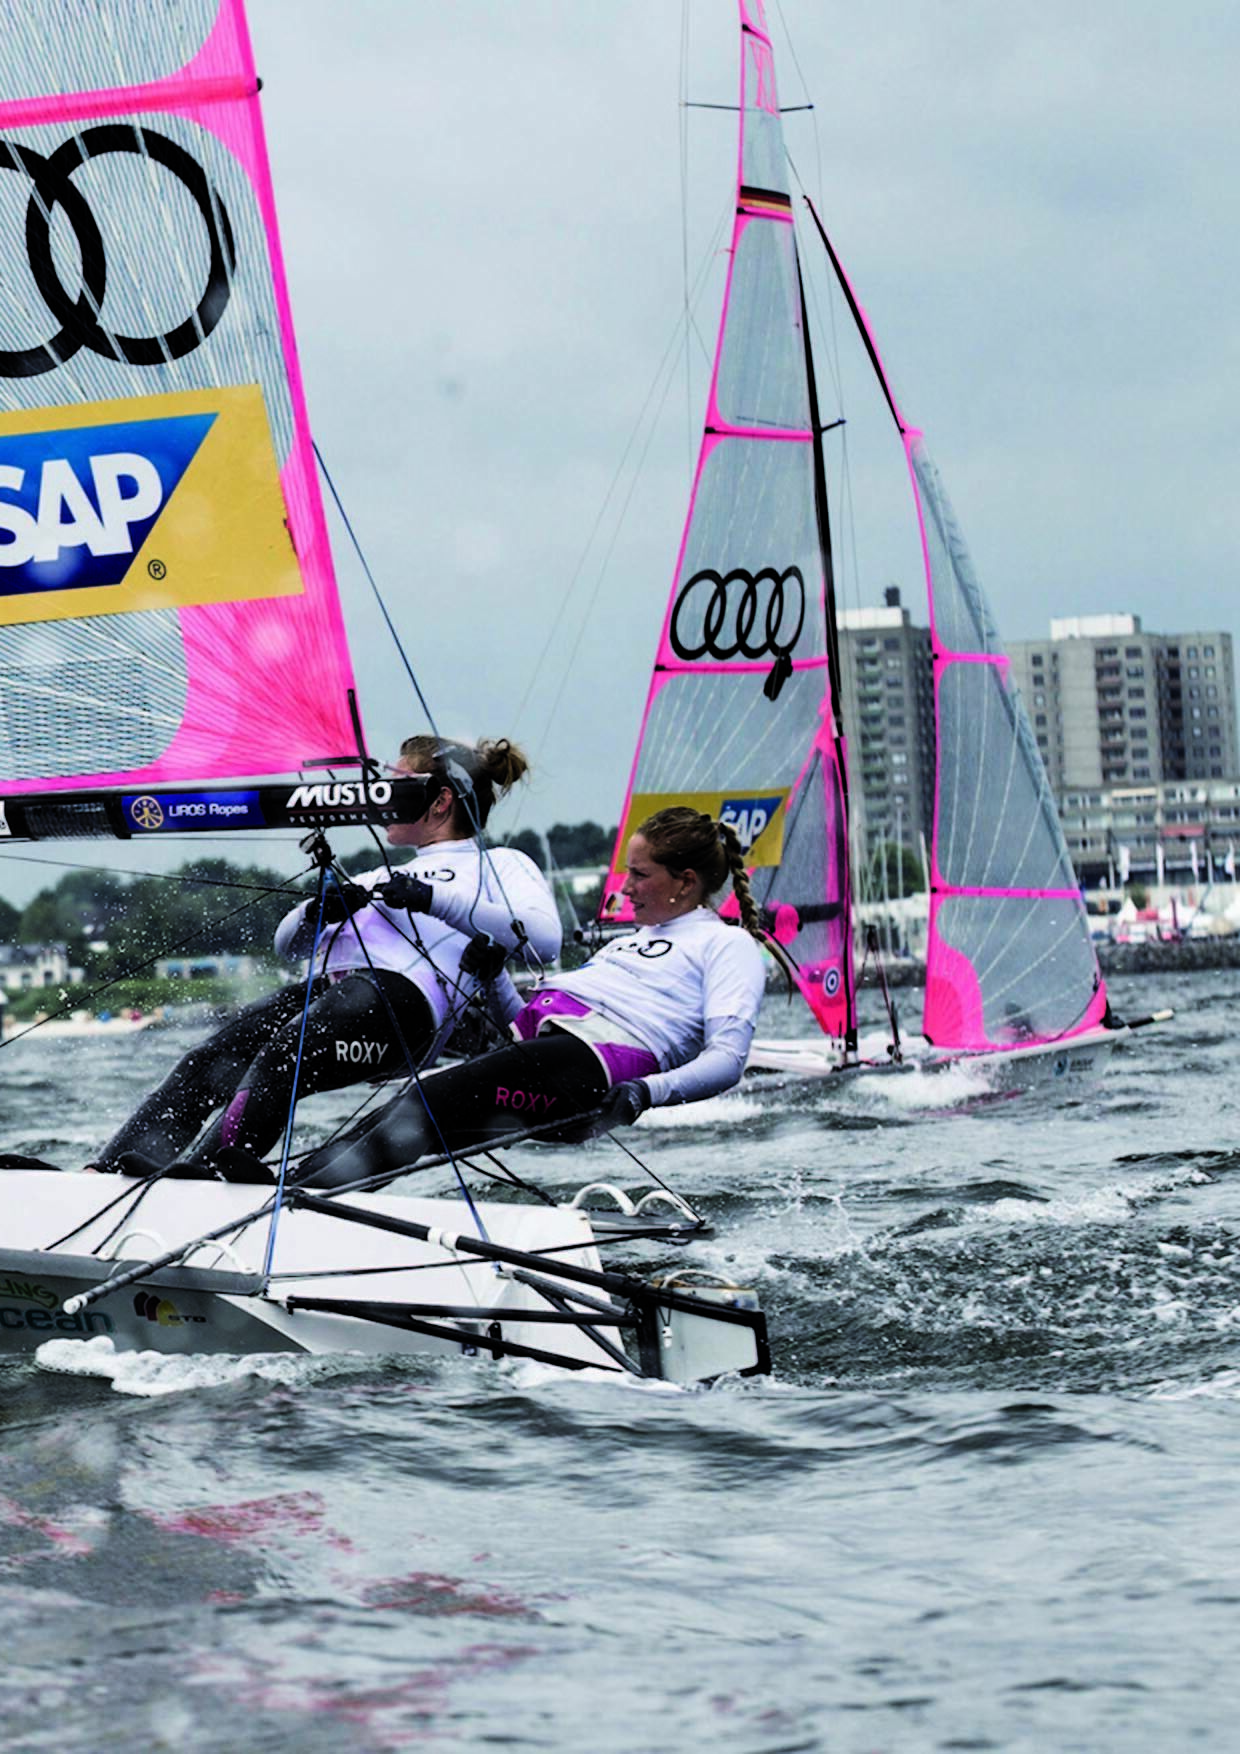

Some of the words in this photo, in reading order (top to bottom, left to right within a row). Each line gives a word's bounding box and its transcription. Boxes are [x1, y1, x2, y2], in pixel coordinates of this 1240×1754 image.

[285, 781, 393, 808] MUSTO
[209, 803, 249, 817] Ropes
[289, 811, 399, 823] PERFORMACE
[335, 1040, 389, 1065] ROXY
[495, 1086, 557, 1112] ROXY
